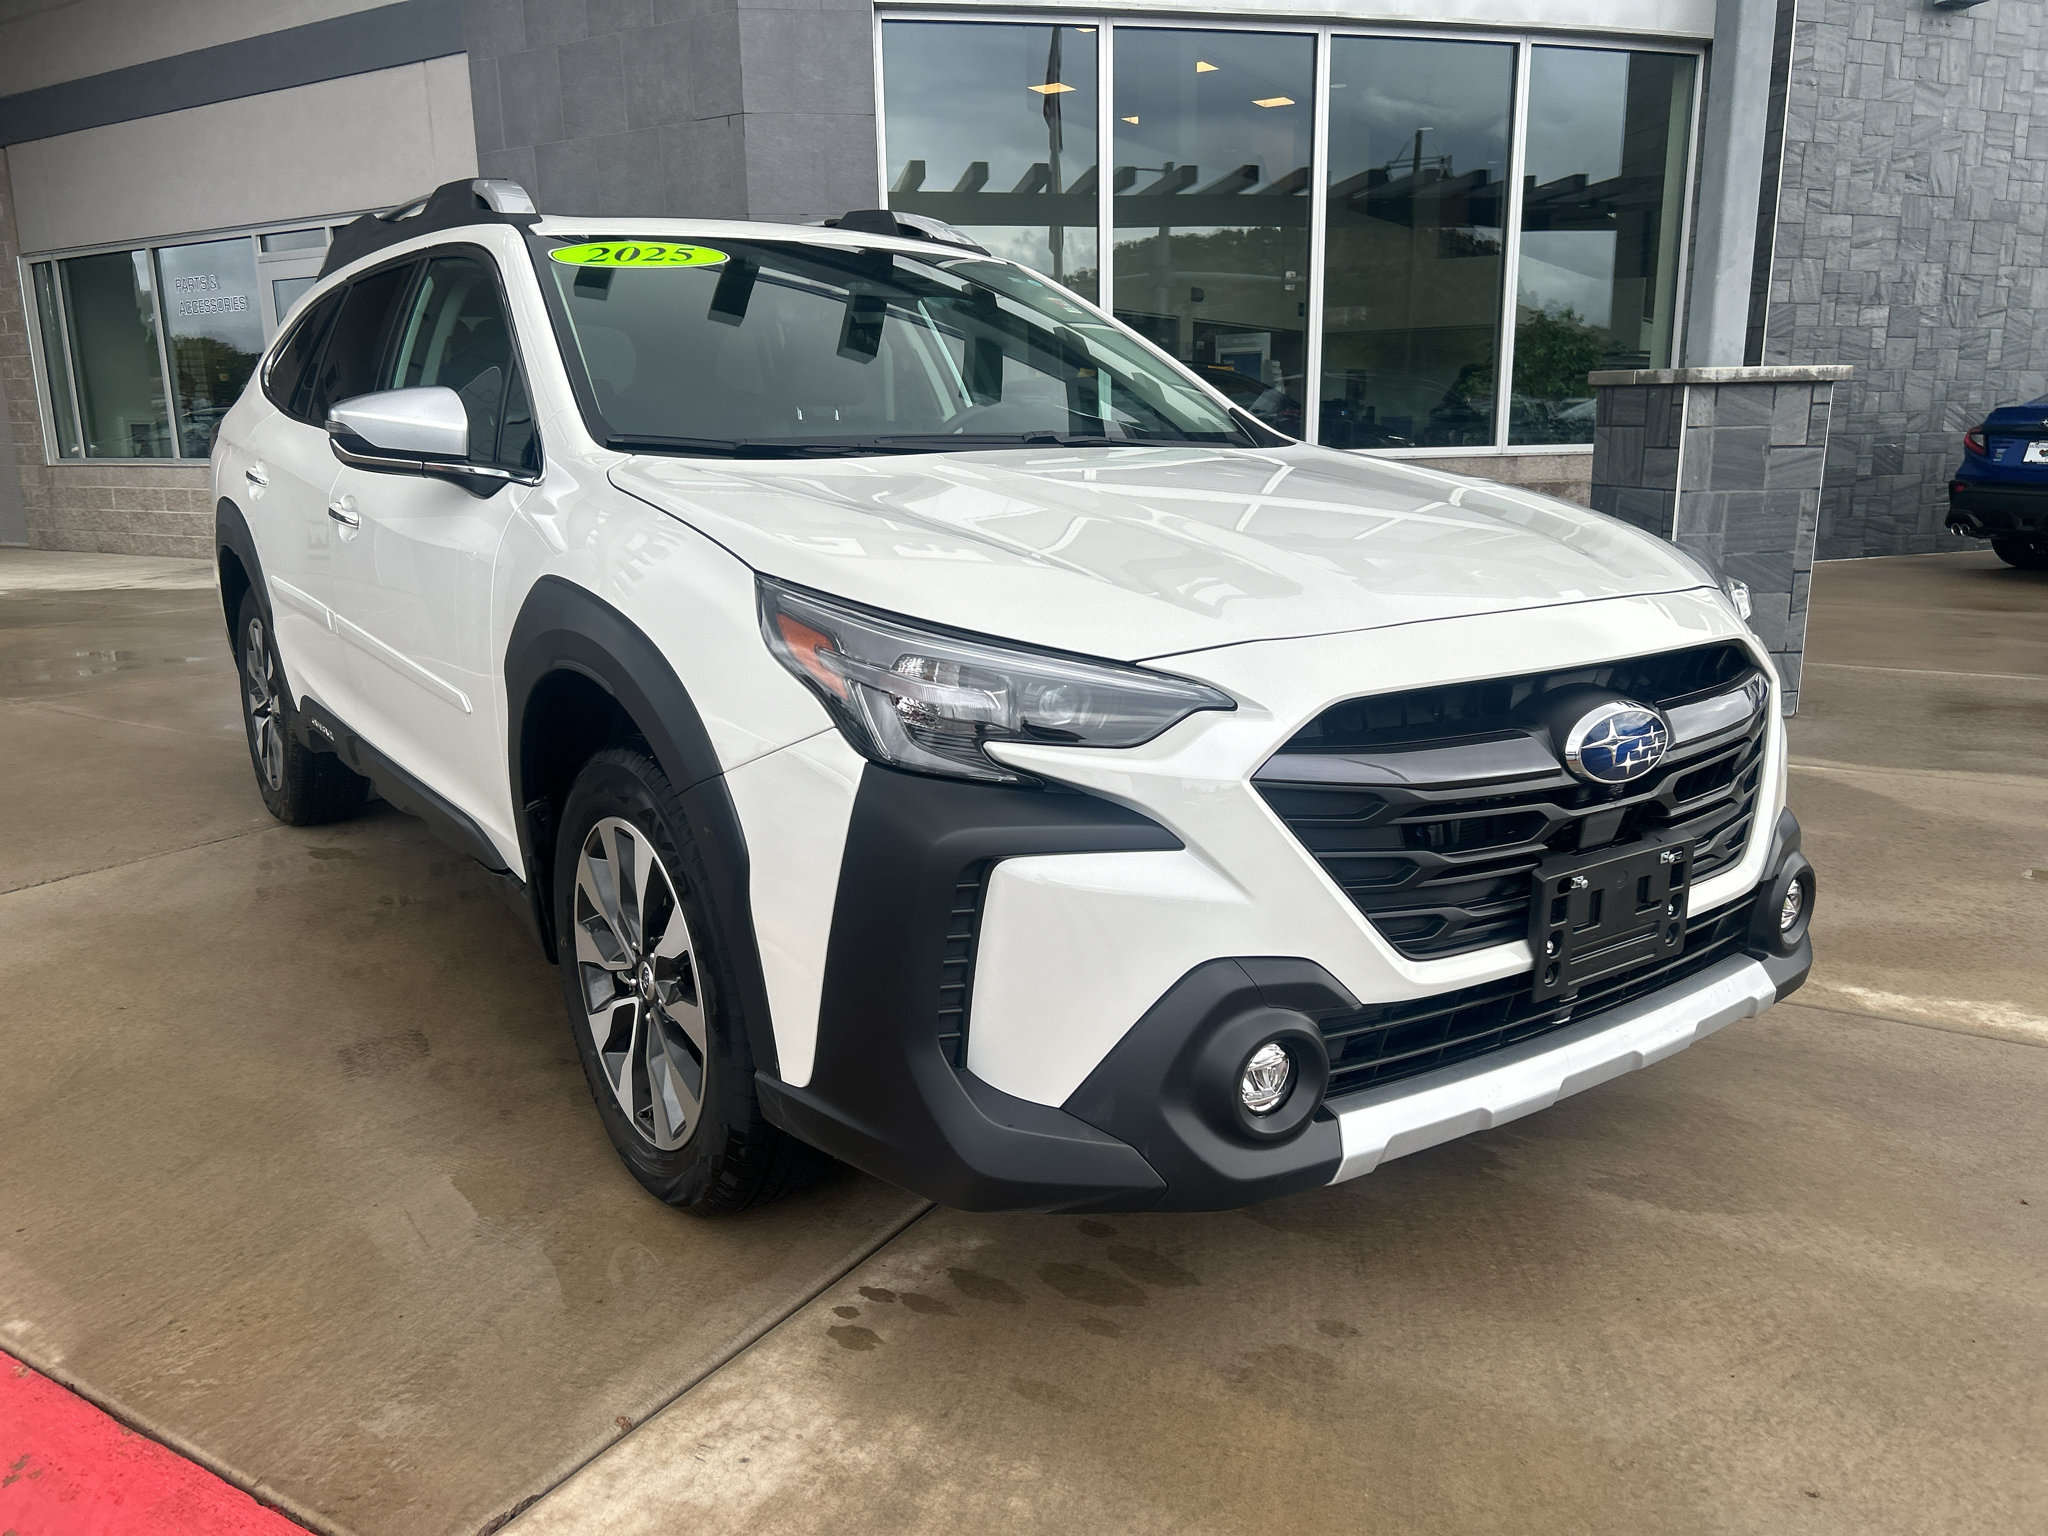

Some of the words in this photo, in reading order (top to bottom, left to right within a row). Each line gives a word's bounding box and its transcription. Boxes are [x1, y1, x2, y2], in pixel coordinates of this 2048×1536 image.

[583, 246, 696, 264] 2025
[175, 275, 208, 293] PARTS
[208, 274, 220, 291] &
[179, 294, 248, 316] ACCESSORIES
